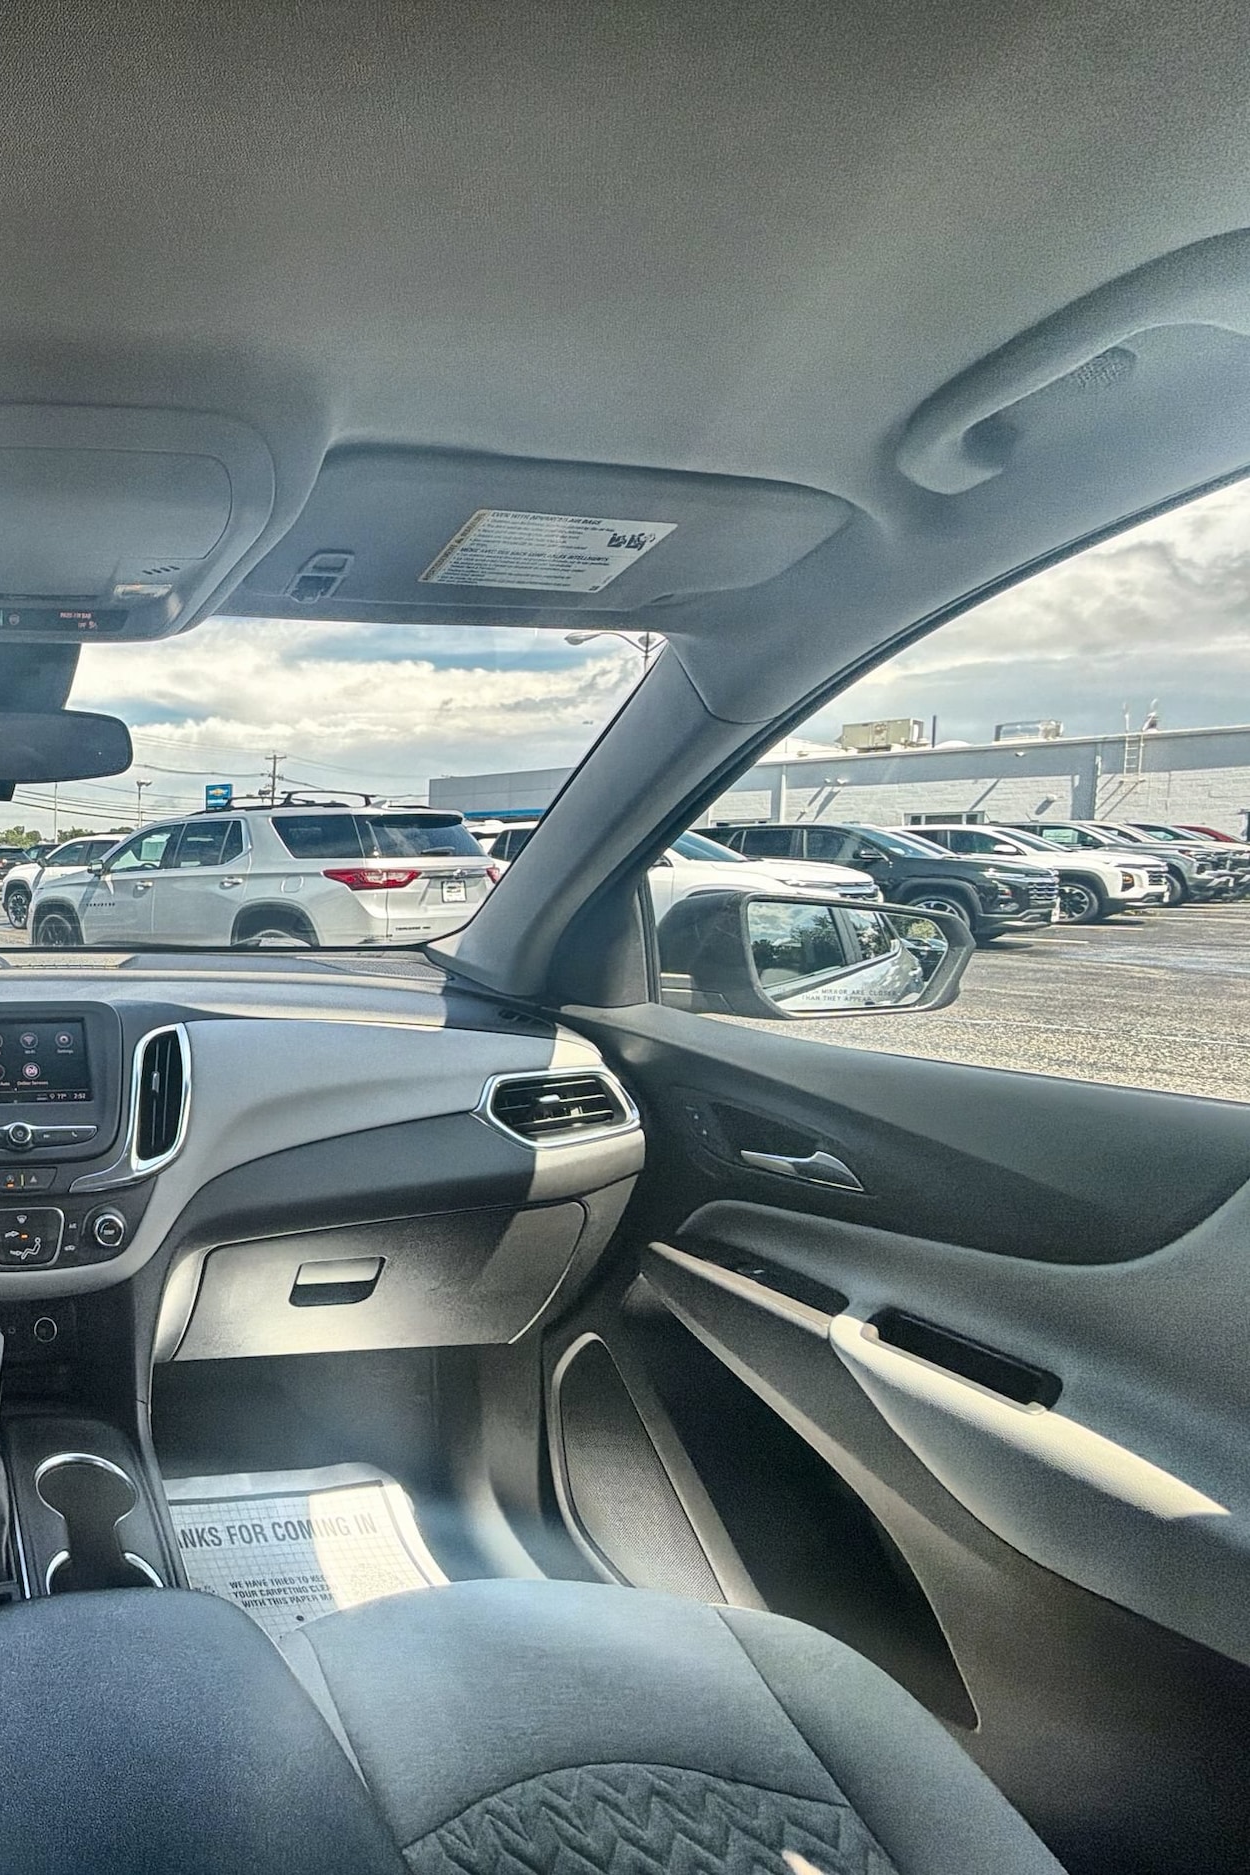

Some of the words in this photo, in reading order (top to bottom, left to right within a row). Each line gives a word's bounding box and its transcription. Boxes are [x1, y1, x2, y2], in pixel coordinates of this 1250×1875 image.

[226, 1523, 269, 1546] FOR
[271, 1516, 351, 1542] COMING
[352, 1512, 379, 1536] IN
[229, 1581, 243, 1590] WE
[245, 1579, 269, 1589] HAVE
[270, 1577, 295, 1587] TRIED
[296, 1575, 309, 1584] TO
[232, 1590, 258, 1599] YOUR
[259, 1585, 309, 1597] CARPETING
[241, 1599, 267, 1608] WITH
[267, 1597, 289, 1606] THIS
[291, 1594, 319, 1604] PAPER
